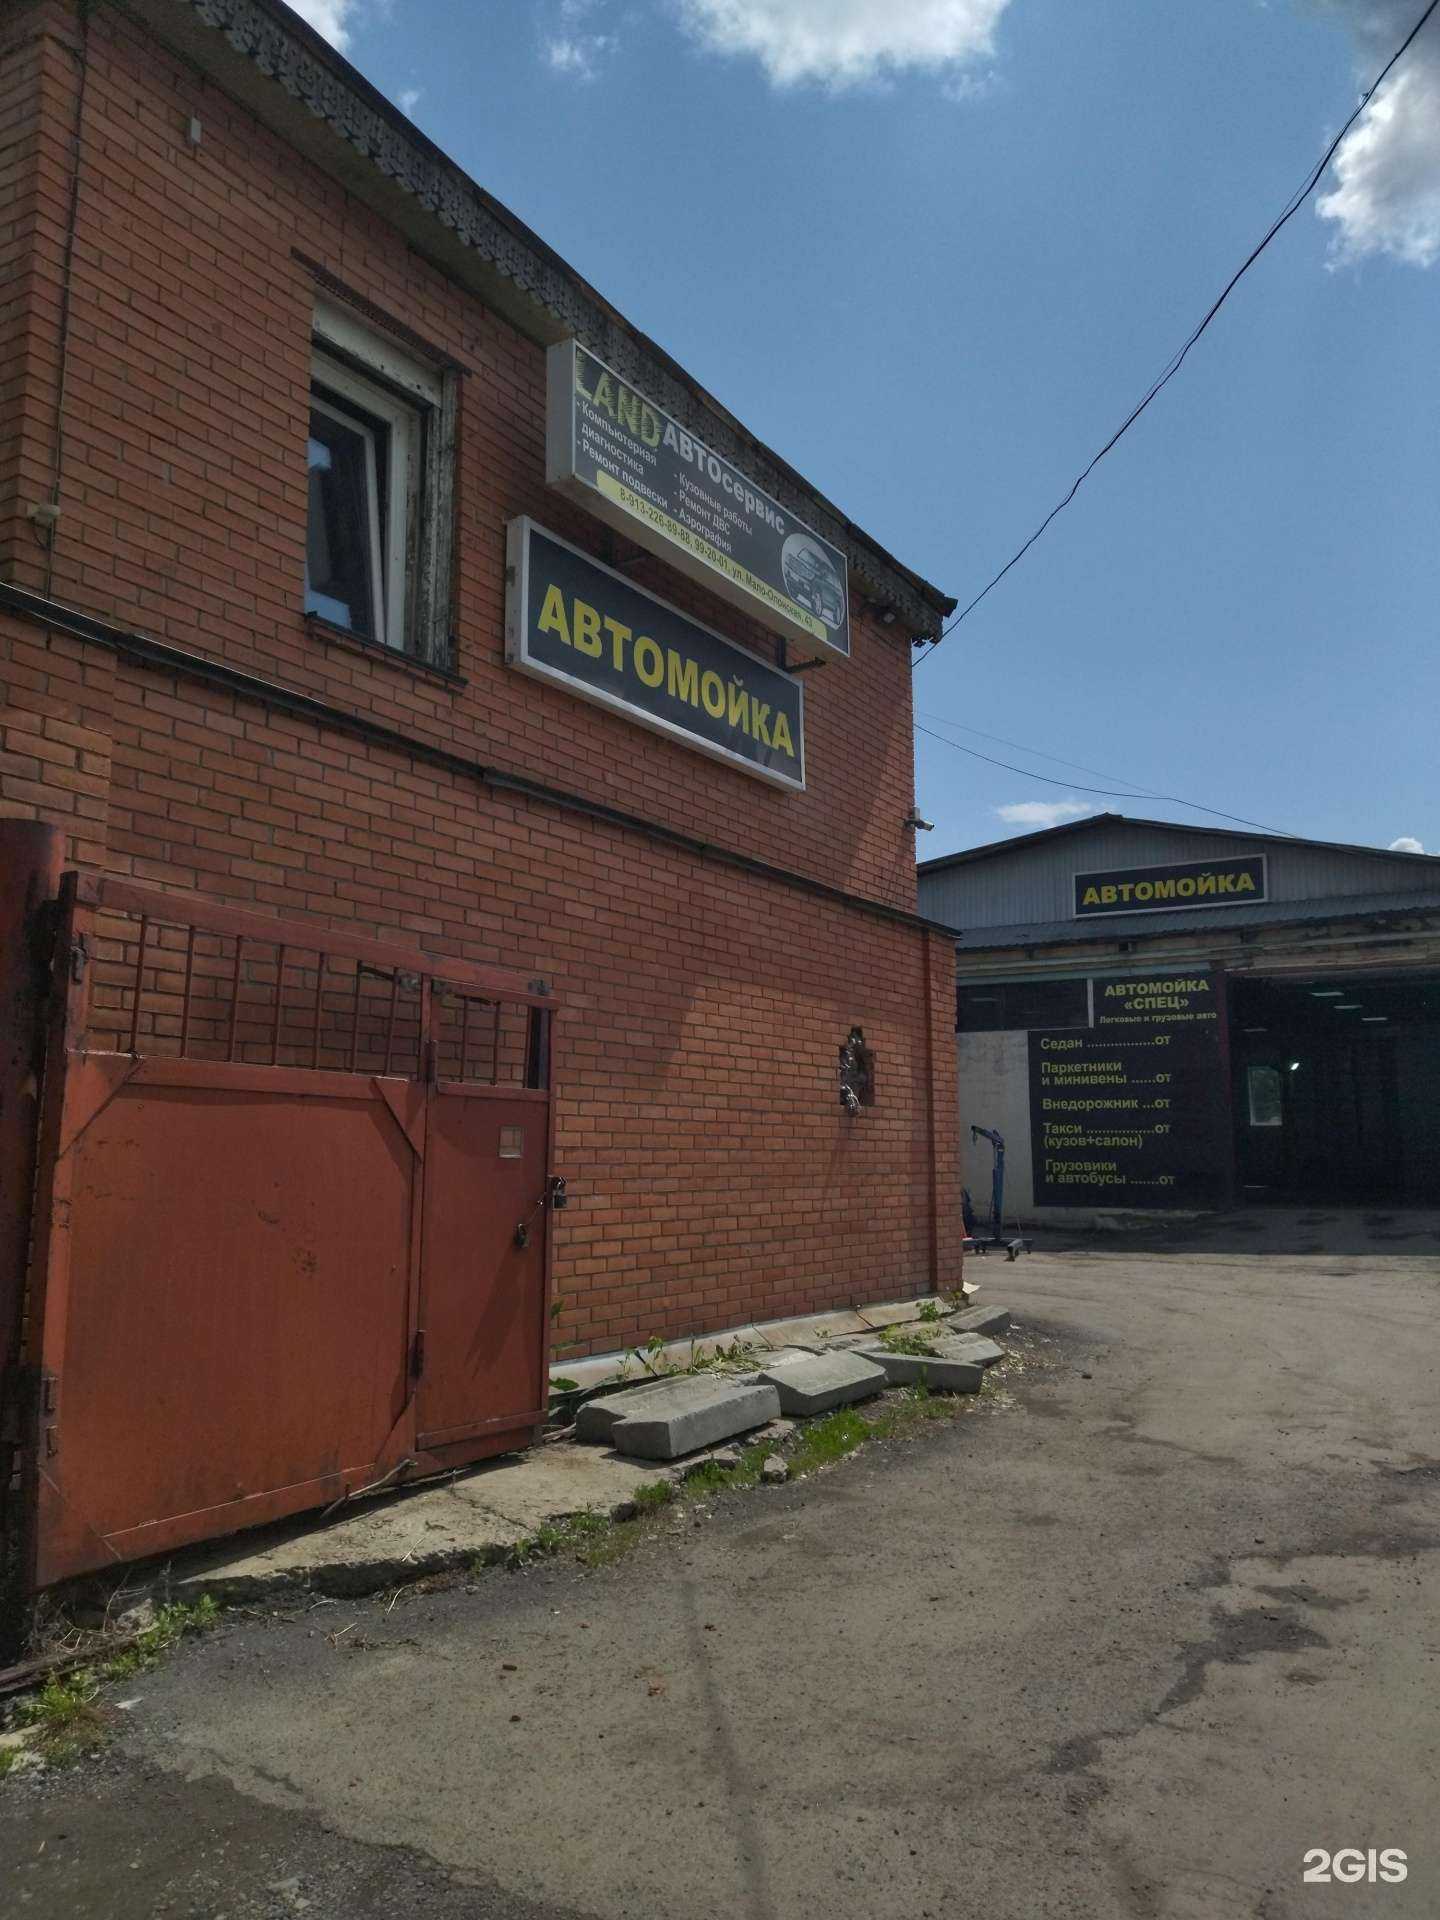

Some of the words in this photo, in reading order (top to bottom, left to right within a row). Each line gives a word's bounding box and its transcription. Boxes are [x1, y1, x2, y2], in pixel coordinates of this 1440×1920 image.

[576, 349, 662, 448] LAND
[582, 400, 657, 466] Компьютерная
[581, 423, 644, 475] диагностика
[582, 439, 620, 477] Ремонт
[622, 470, 668, 509] подвески
[679, 472, 722, 512] Кузовные
[723, 506, 753, 537] работы
[679, 489, 711, 520] Ремонт
[712, 514, 731, 536] ДВС
[679, 508, 732, 554] Аэрография
[537, 583, 795, 758] АВТОМОЙКА
[1082, 872, 1256, 906] АВТОМОЙКА
[1104, 978, 1210, 997] АВТОМОЙКА
[1040, 1038, 1083, 1050] Седан
[1041, 1062, 1122, 1075] Паркетники
[1042, 1077, 1050, 1086] и
[1054, 1075, 1127, 1086] минивены
[1042, 1098, 1138, 1112] Внедорожник
[1043, 1122, 1082, 1135] Такси
[1044, 1135, 1143, 1150] (кузов+салон)
[1045, 1160, 1117, 1173] Грузовики
[1046, 1174, 1054, 1184] и
[1058, 1172, 1126, 1187] автобусы
